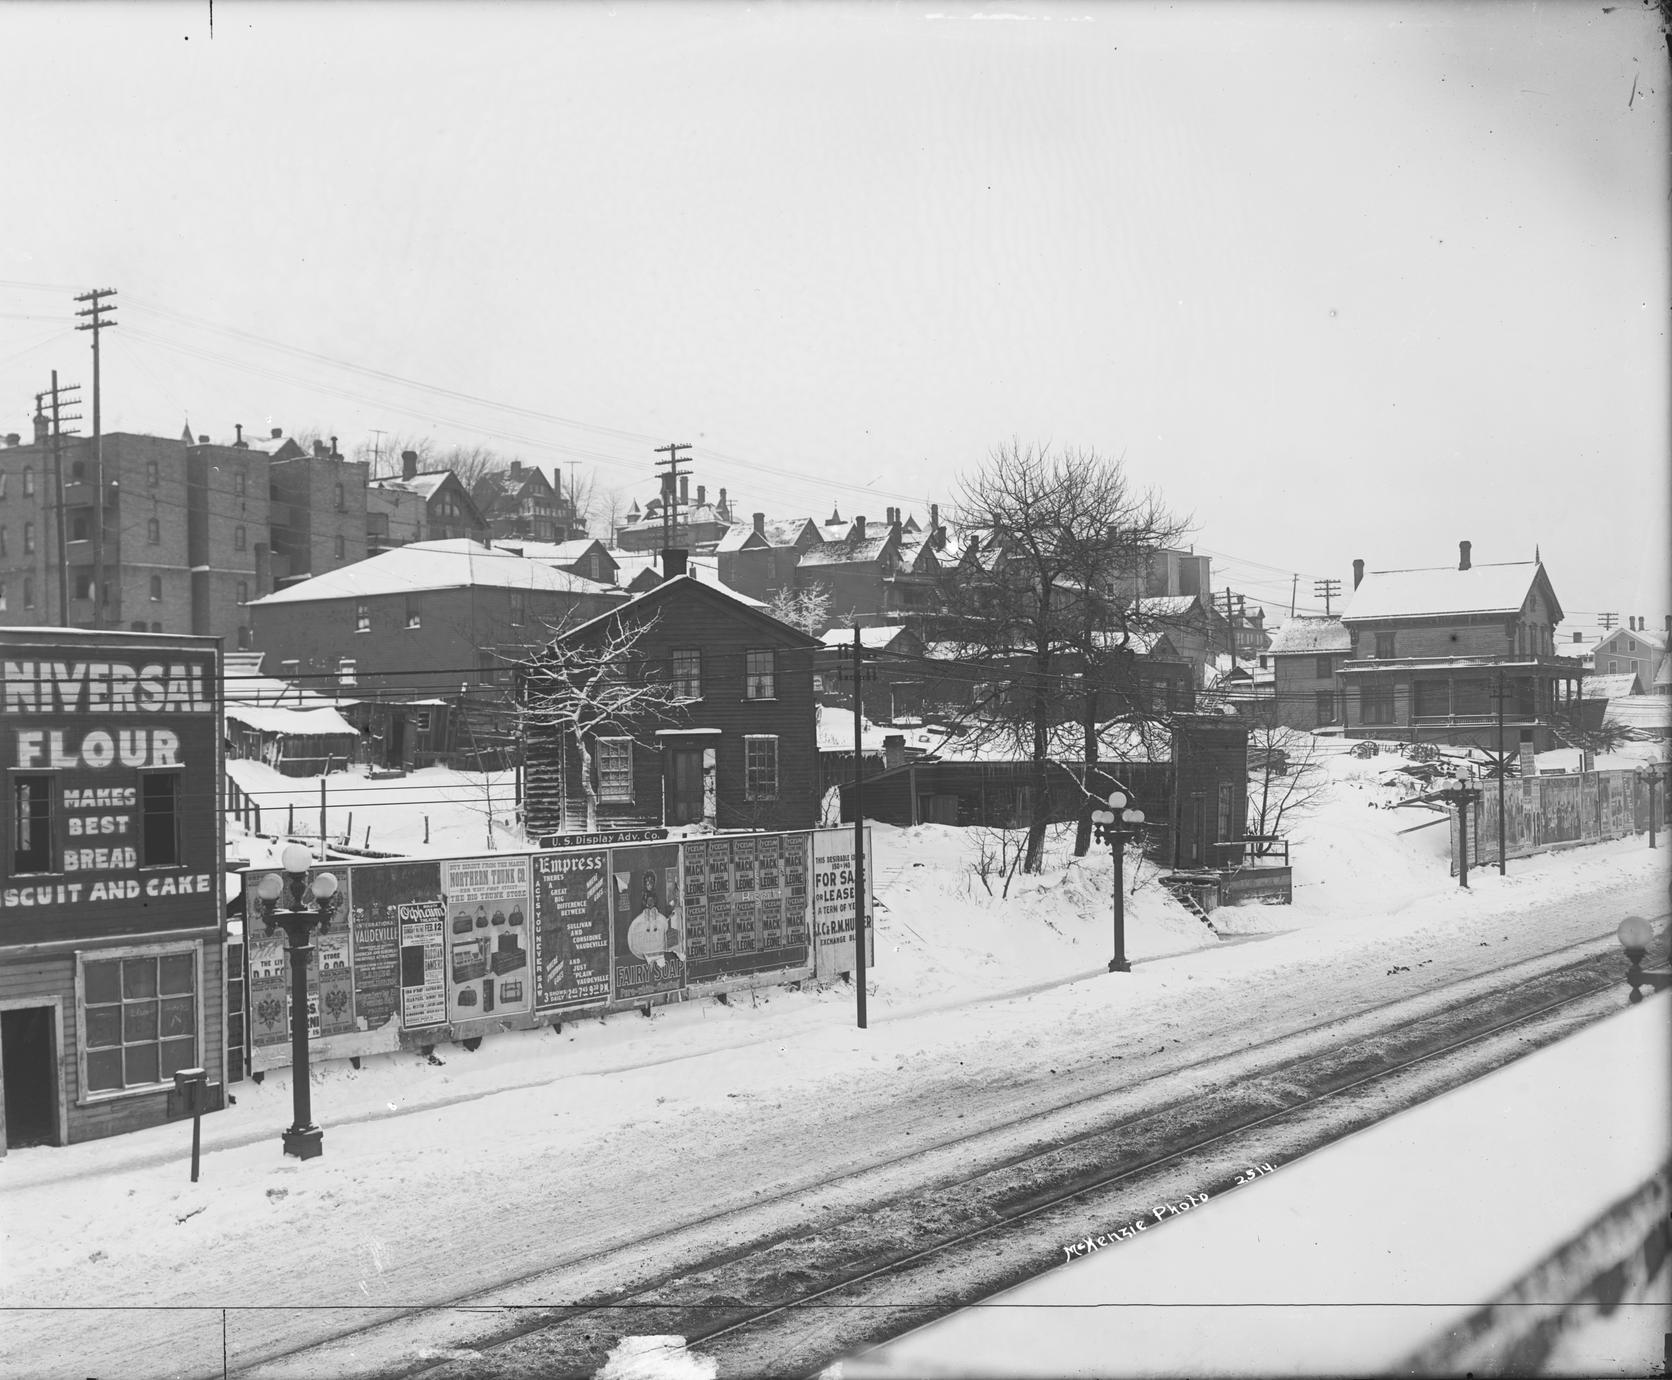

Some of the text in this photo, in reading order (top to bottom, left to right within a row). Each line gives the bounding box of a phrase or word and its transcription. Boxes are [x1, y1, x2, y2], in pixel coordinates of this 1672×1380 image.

[4, 661, 212, 712] NIVERSAL
[18, 730, 180, 768] FLOUR
[63, 787, 137, 808] MAKES
[68, 815, 129, 836] BEST
[576, 834, 614, 845] Display
[618, 833, 640, 842] Adv.
[644, 831, 660, 840] Co.
[63, 847, 137, 871] BREAD
[760, 859, 777, 869] MACK
[785, 856, 802, 866] MACK
[827, 854, 850, 863] DESIRABLE
[540, 856, 602, 873] Empress
[686, 864, 704, 876] MACK
[710, 862, 728, 873] MACK
[735, 860, 753, 871] MACK
[449, 870, 489, 888] NORTHERN
[491, 868, 515, 885] TRUNK
[760, 876, 778, 887] LEONE
[786, 873, 803, 885] LEONE
[816, 871, 837, 888] FOR
[686, 883, 705, 895] LEONE
[711, 880, 729, 892] LEONE
[736, 879, 755, 890] LEONE
[0, 874, 211, 907] SCUIT AND CAKE
[480, 891, 504, 900] TRUNK
[550, 888, 567, 896] GREAT
[816, 887, 855, 902] OR LEASE
[557, 900, 588, 910] DIFFERENCE
[817, 906, 822, 915] A
[823, 904, 838, 914] TERM
[840, 903, 847, 912] OF
[561, 908, 586, 917] BETWEEN
[566, 921, 592, 930] SULLIVAN
[763, 919, 780, 930] MACK
[787, 915, 803, 926] MACK
[844, 915, 872, 932] HUER
[434, 922, 442, 931] 12
[713, 922, 730, 934] MACK
[737, 921, 754, 932] MACK
[354, 927, 398, 943] VAUDEVILLE
[570, 929, 583, 937] AND
[687, 927, 705, 938] MACK
[575, 940, 608, 950] VAUDEVILLE
[737, 939, 756, 951] LEONE
[764, 937, 781, 948] LEONE
[787, 934, 805, 945] LEONE
[820, 935, 846, 946] EXCHANGE
[688, 945, 706, 957] LEONE
[713, 941, 731, 953] LEONE
[616, 959, 685, 987] FAIRY SOAP
[577, 974, 609, 985] VAUDEVILLE
[544, 992, 549, 1003] 3
